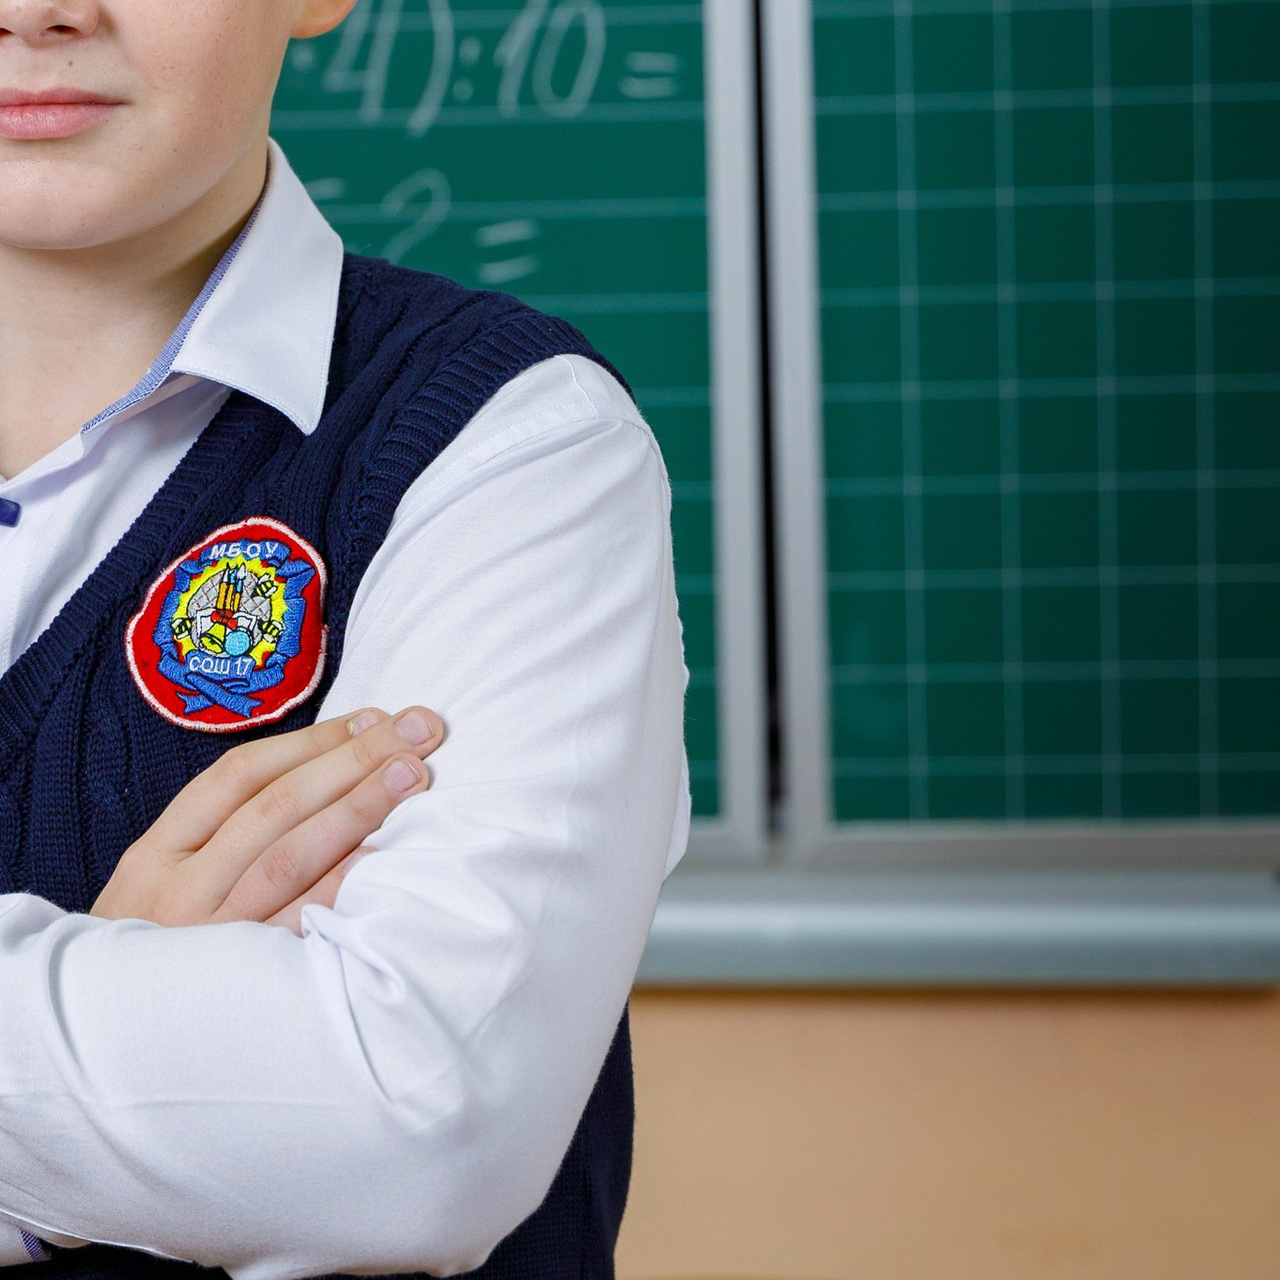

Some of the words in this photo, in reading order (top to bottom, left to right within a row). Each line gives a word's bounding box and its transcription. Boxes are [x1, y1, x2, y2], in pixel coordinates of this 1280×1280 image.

[209, 541, 280, 560] МБОУ
[188, 655, 231, 676] СОШ
[234, 656, 253, 676] 17
